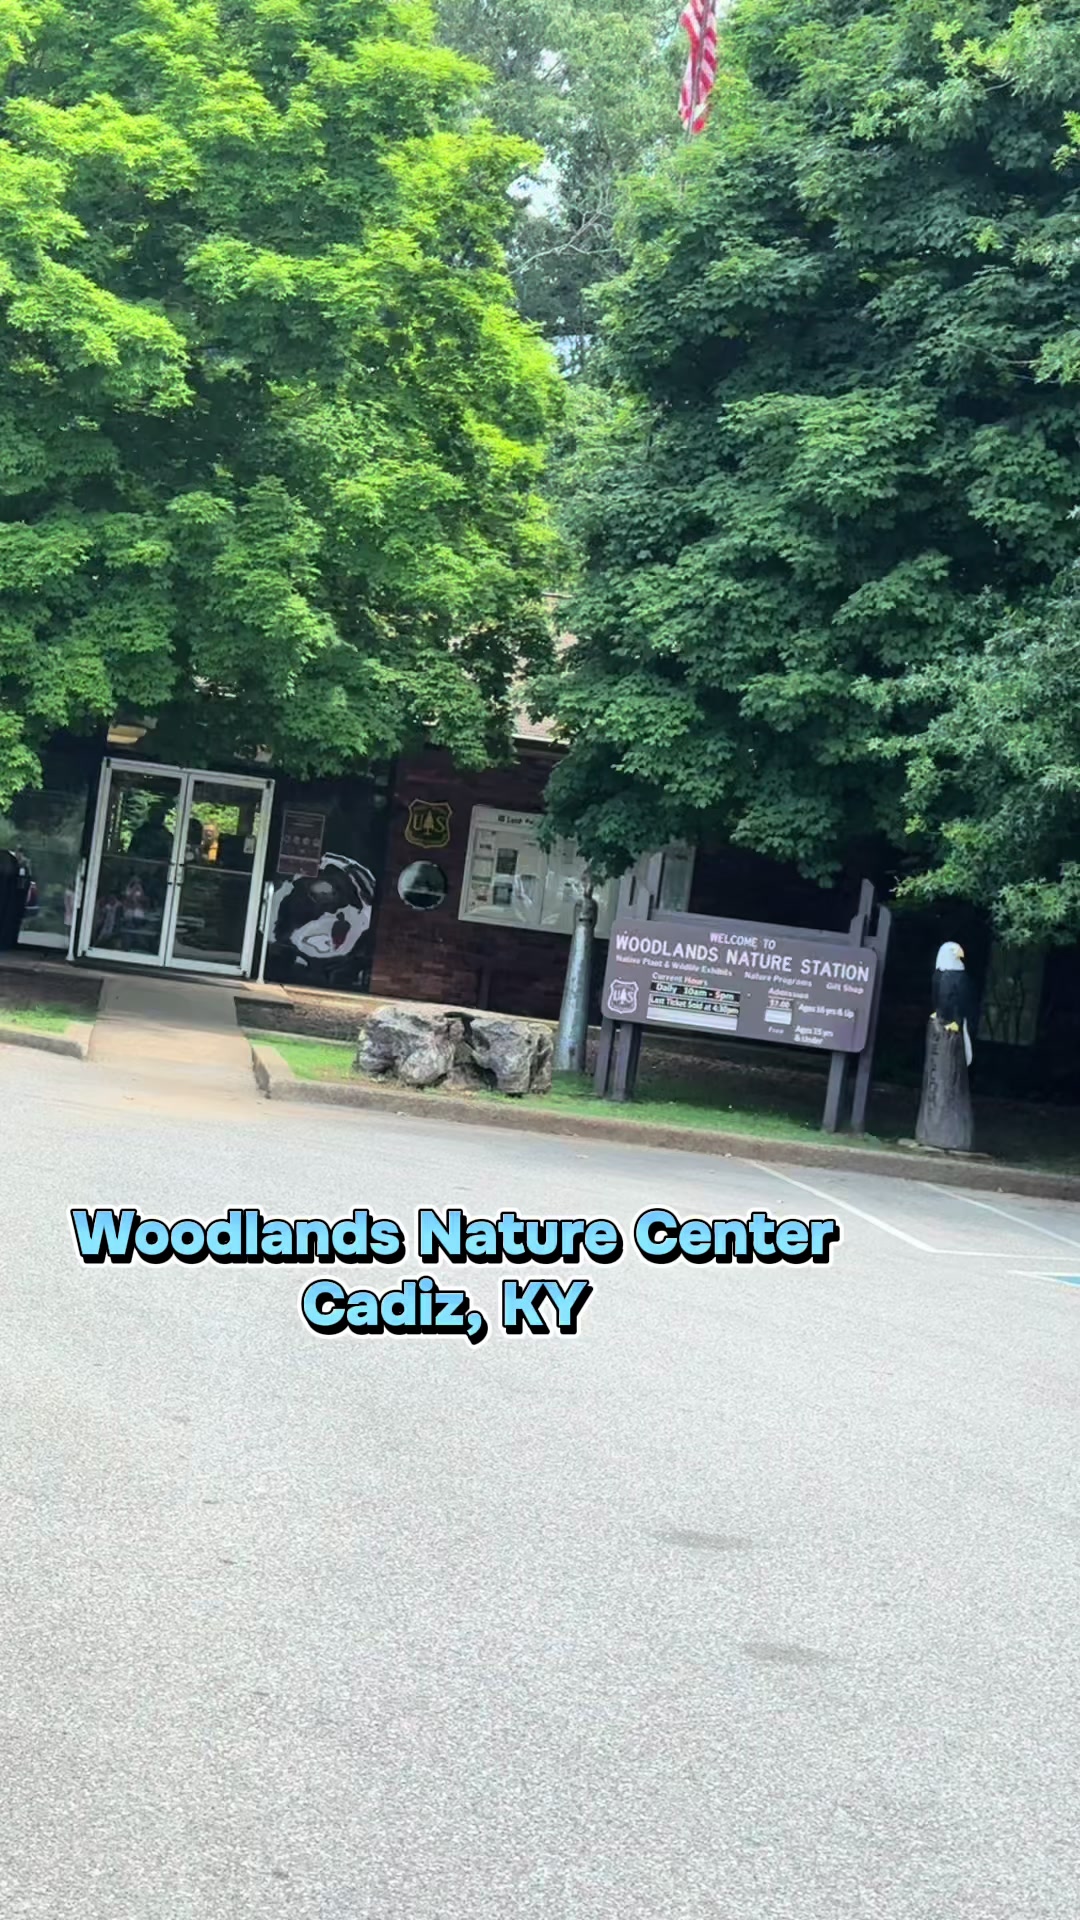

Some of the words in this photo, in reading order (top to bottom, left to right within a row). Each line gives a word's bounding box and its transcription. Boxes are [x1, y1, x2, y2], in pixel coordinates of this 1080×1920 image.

[709, 932, 757, 948] WELCOME
[763, 938, 777, 950] TO
[615, 934, 719, 962] WOODLANDS
[726, 949, 793, 972] NATURE
[801, 958, 869, 982] STATION
[615, 954, 641, 965] Native
[642, 958, 663, 968] Plant
[671, 961, 700, 972] Wildlife
[701, 965, 733, 977] Exhibits
[652, 971, 683, 983] Current
[684, 975, 708, 986] Hours
[744, 971, 772, 982] Nature
[773, 974, 813, 987] Programs
[656, 981, 678, 994] Daily
[684, 986, 708, 998] 10am
[714, 990, 735, 1002] 5pm
[768, 986, 809, 1000] Admission
[826, 981, 842, 992] Gift
[843, 984, 865, 995] Shop
[649, 993, 666, 1004] Last
[666, 996, 687, 1008] Ticket
[688, 998, 704, 1010] Sold
[704, 1002, 711, 1011] at
[798, 1003, 816, 1014] Ages
[794, 1024, 812, 1035] Ages
